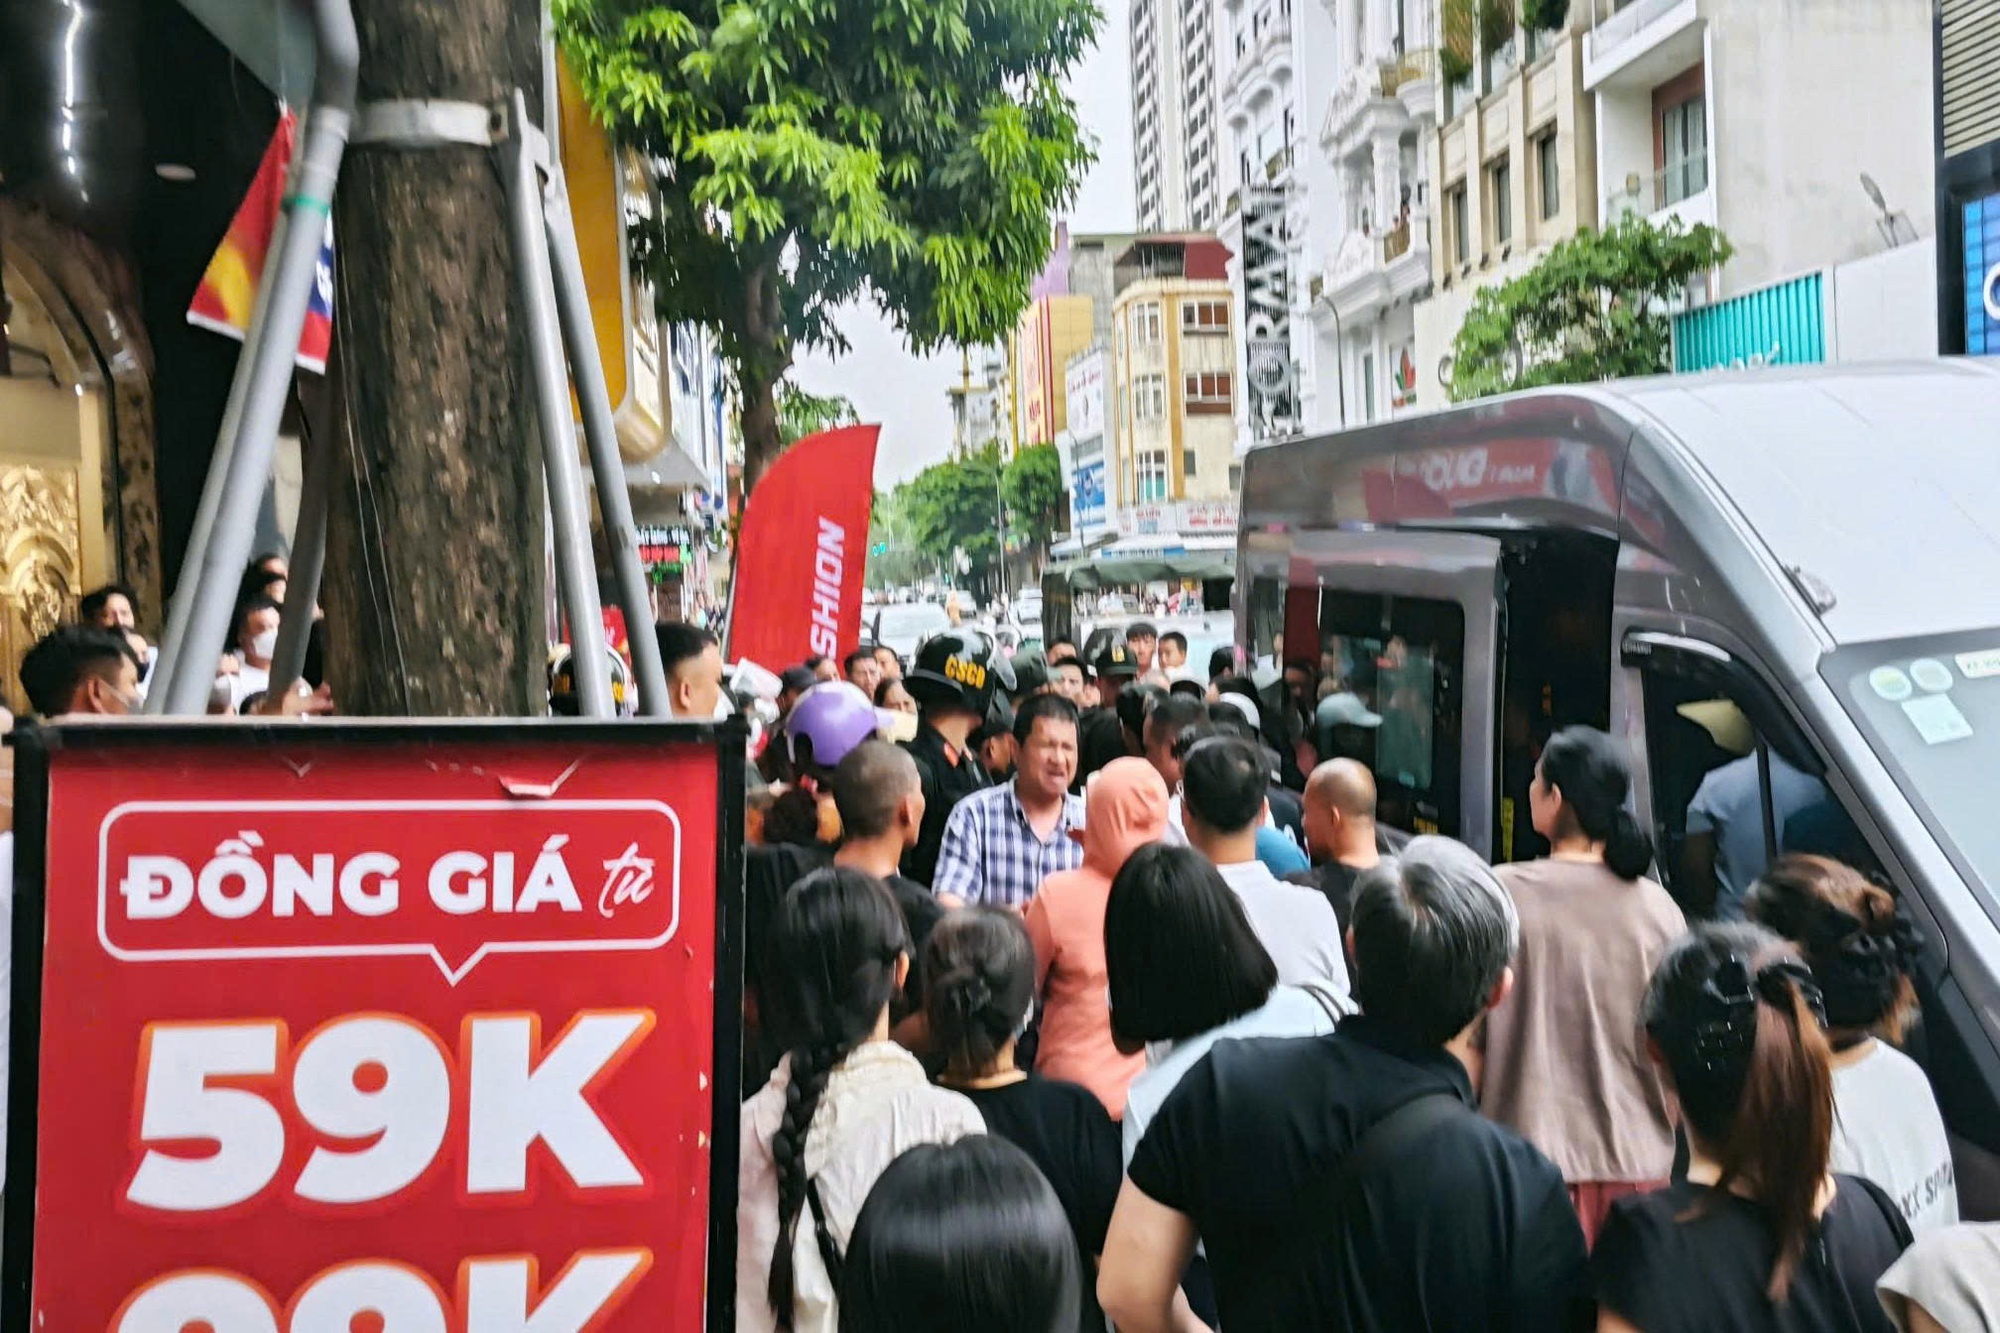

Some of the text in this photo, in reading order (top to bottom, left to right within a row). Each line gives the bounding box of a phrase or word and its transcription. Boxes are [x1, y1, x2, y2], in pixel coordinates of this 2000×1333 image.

[120, 831, 655, 919] ĐỒNG GIÁ từ
[126, 1014, 645, 1211] 59K
